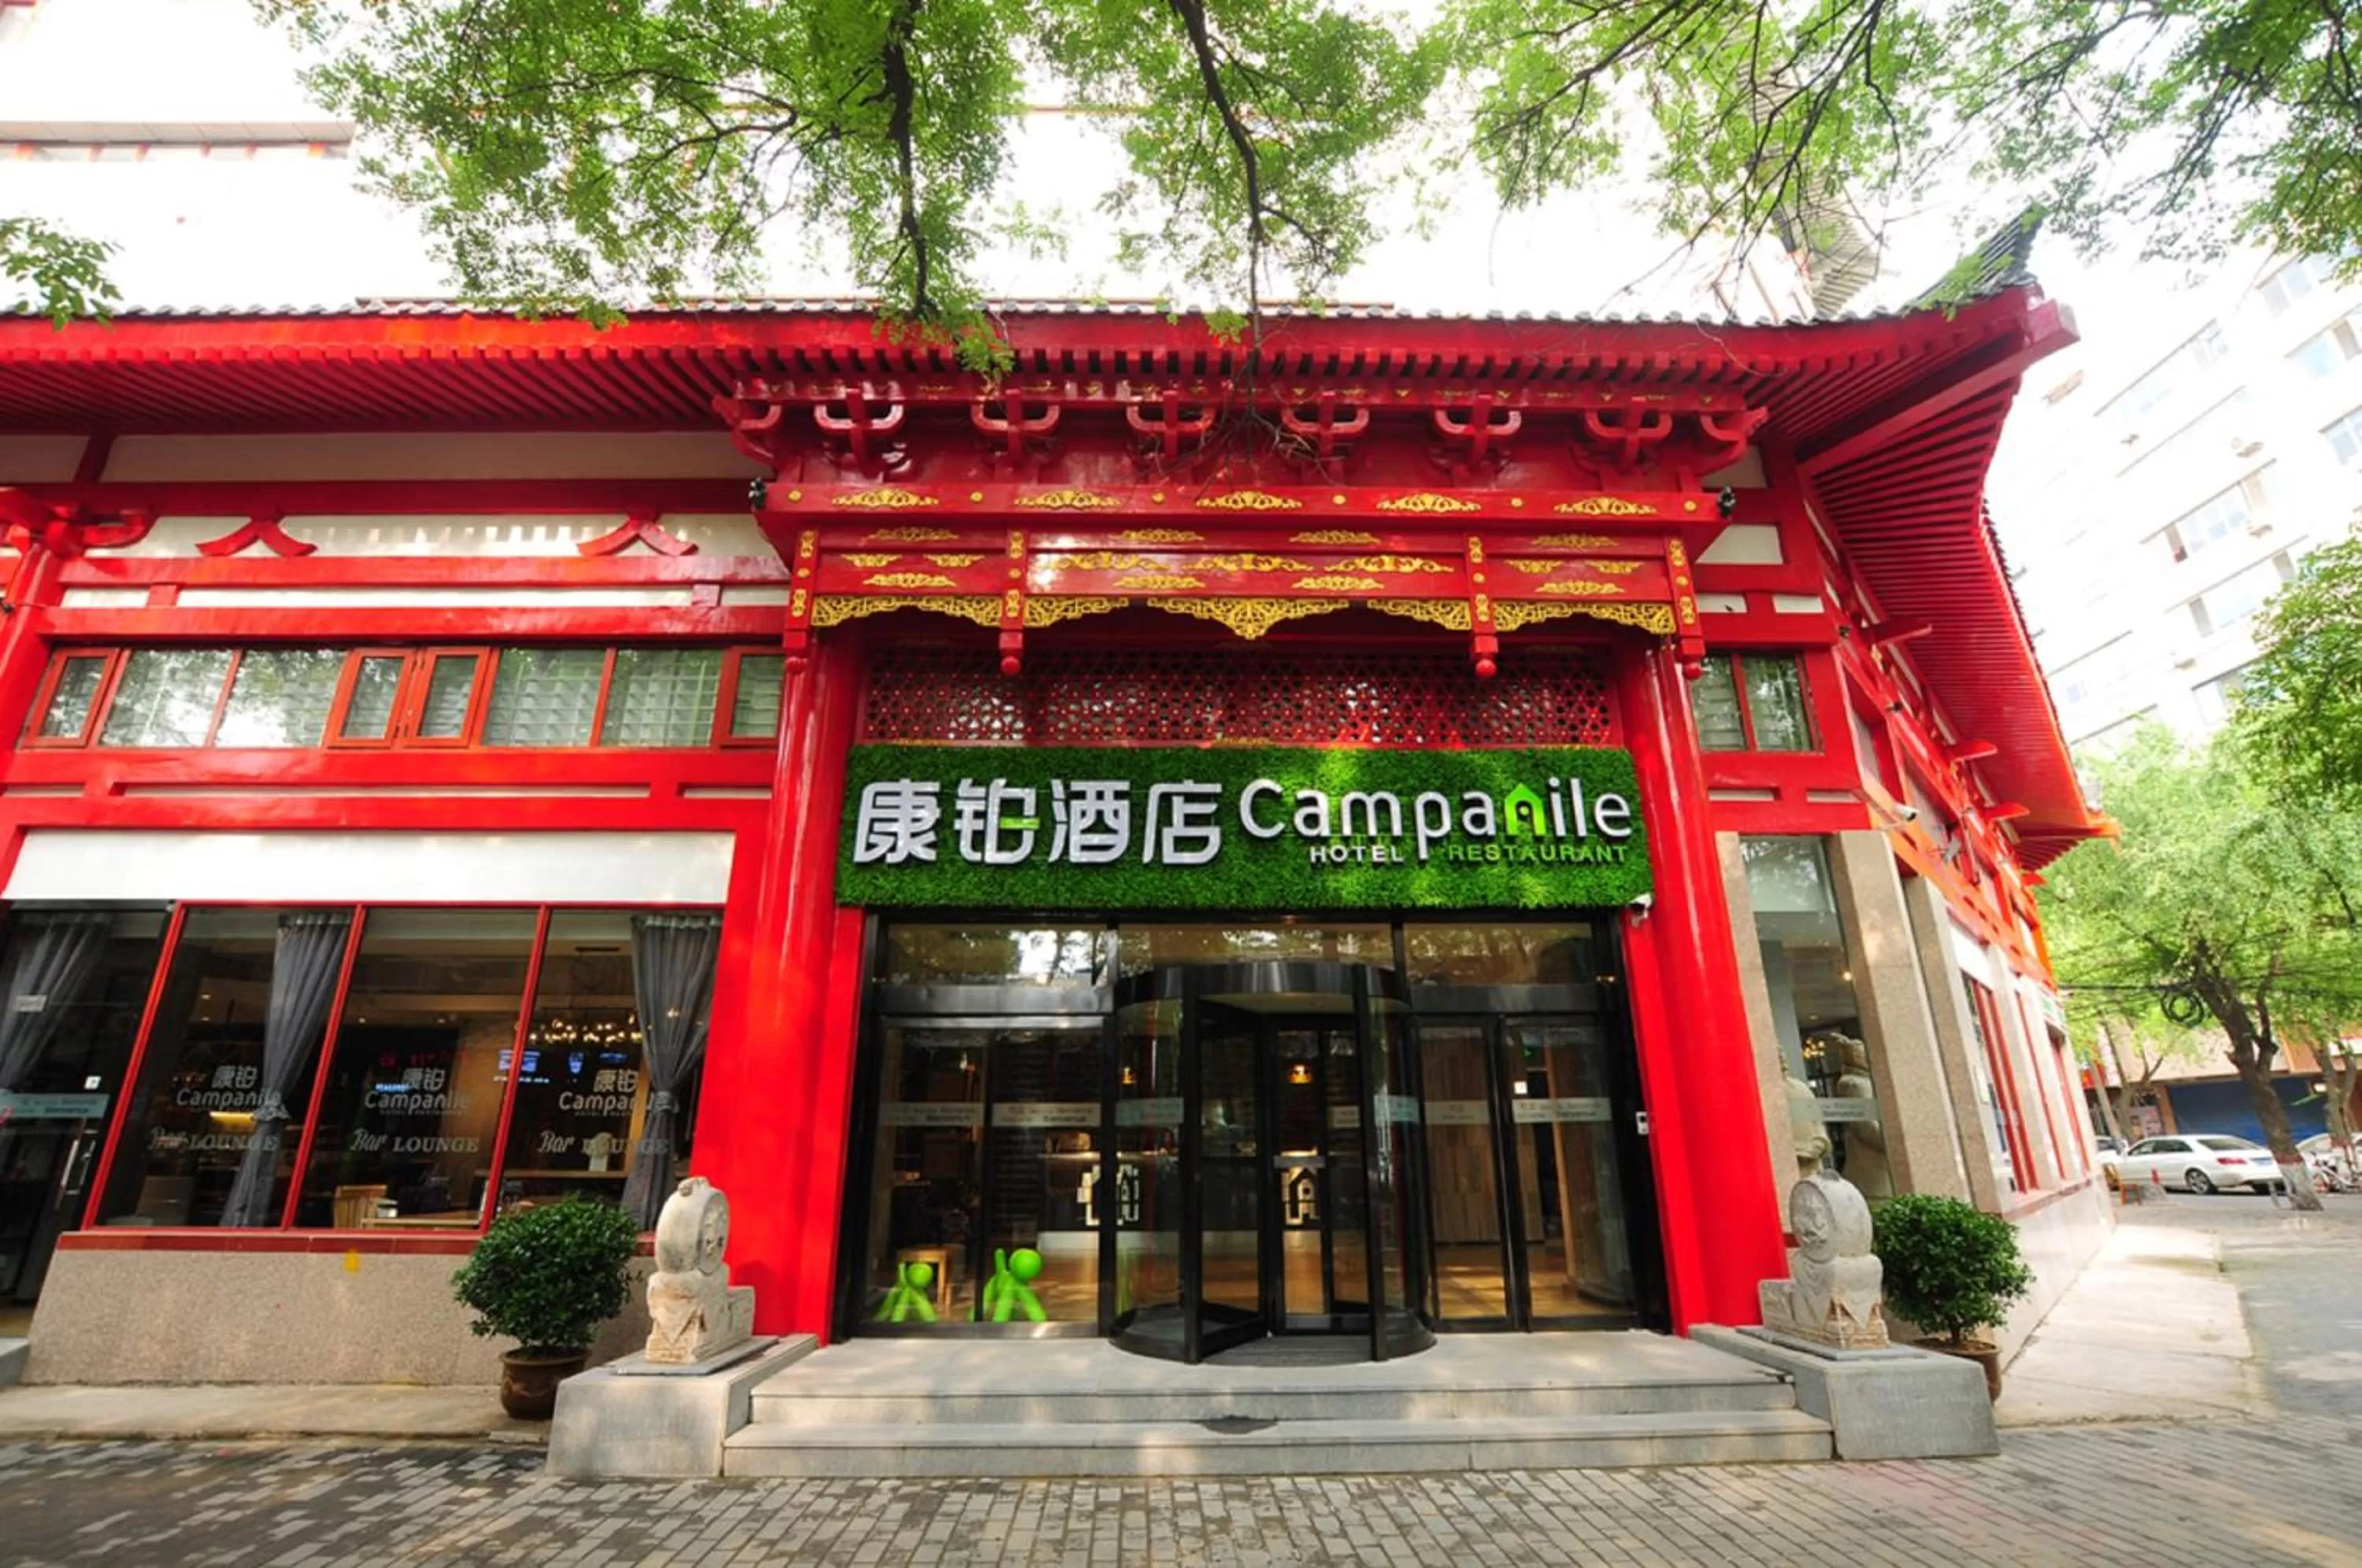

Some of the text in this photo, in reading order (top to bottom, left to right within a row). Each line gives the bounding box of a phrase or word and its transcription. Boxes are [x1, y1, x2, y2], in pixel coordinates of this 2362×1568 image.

[853, 778, 1222, 864] 康铂酒店
[1239, 777, 1632, 860] Campanile
[1310, 843, 1629, 864] HOTEL RESTAURANT
[350, 1126, 480, 1153] Bar LOUNGE
